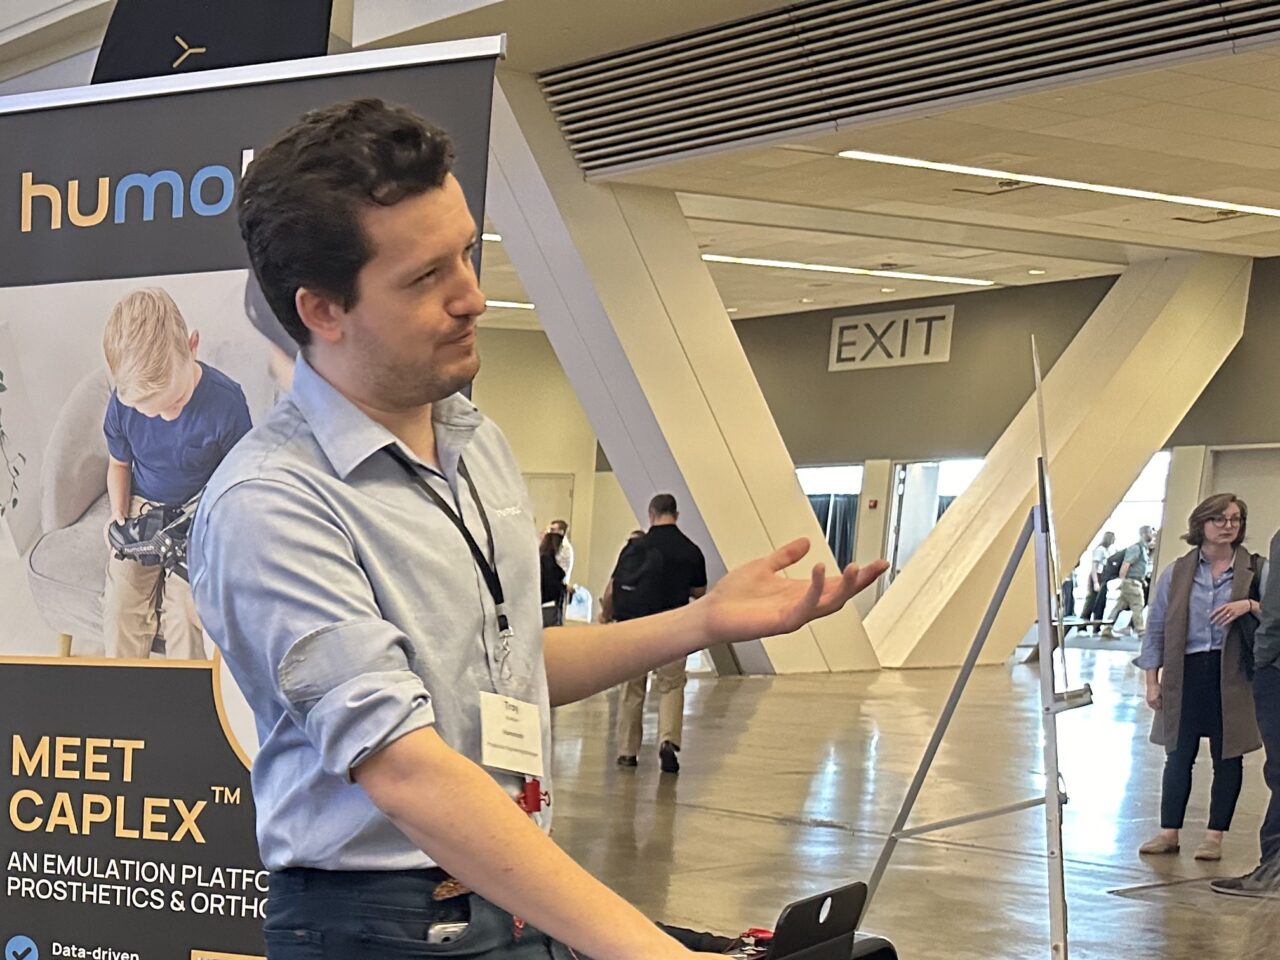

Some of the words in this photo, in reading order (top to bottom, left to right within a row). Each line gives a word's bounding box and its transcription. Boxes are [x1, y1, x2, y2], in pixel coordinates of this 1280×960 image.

[21, 148, 254, 232] humo
[835, 315, 946, 364] EXIT
[11, 734, 145, 783] MEET
[7, 851, 38, 873] AN
[43, 854, 176, 885] EMULATION
[7, 876, 165, 910] PROSTHETICS
[169, 891, 186, 912] &
